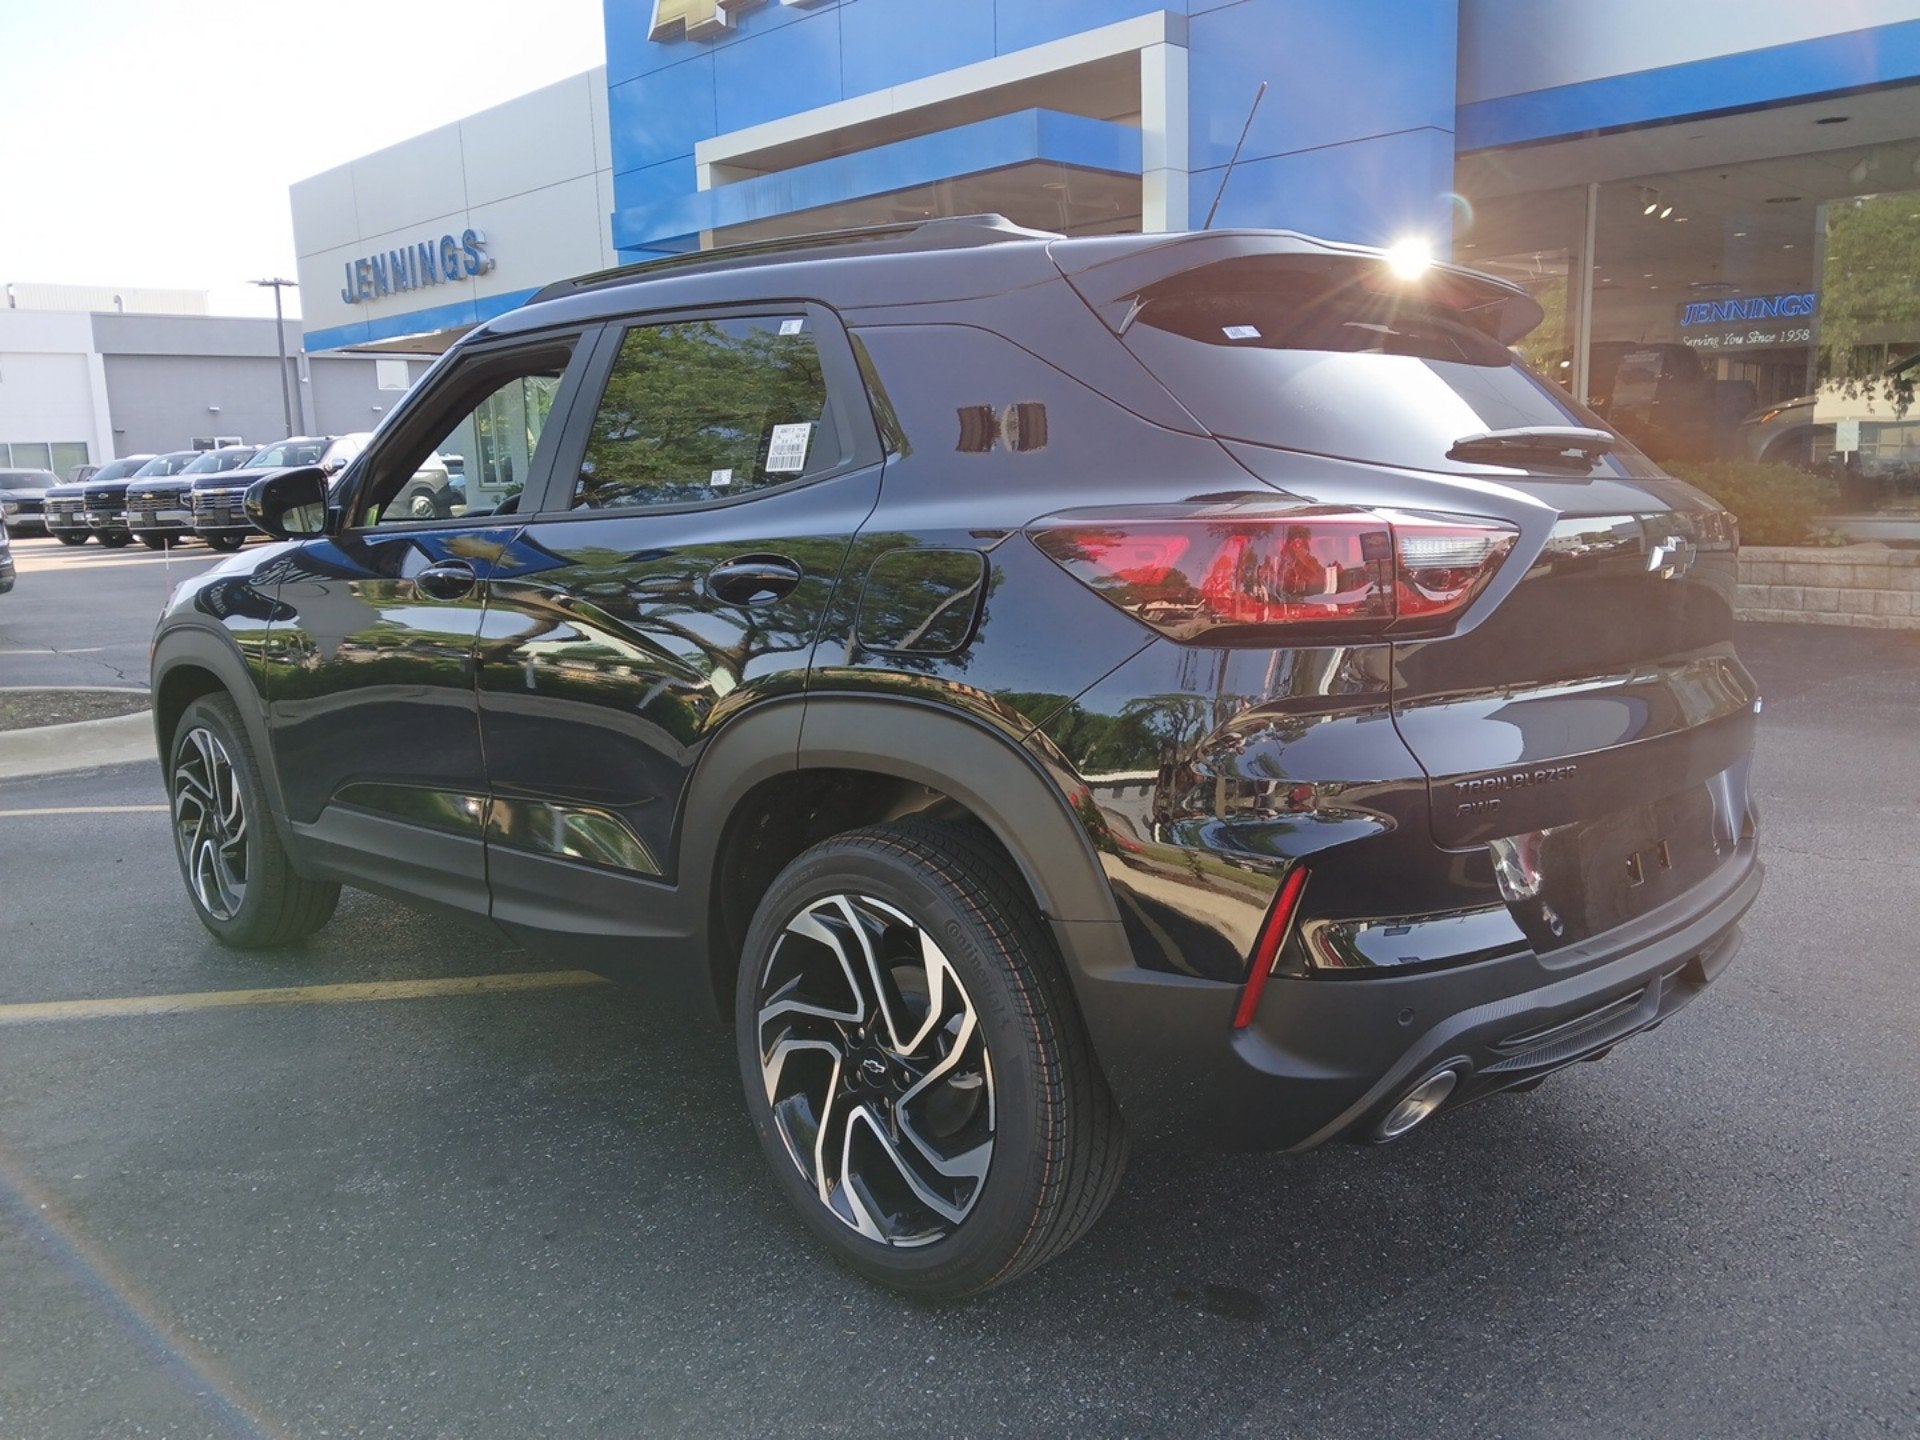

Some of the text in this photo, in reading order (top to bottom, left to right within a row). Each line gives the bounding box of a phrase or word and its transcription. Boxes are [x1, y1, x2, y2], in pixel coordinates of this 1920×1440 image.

[341, 229, 487, 304] JENNINGS
[1680, 293, 1816, 326] JENNINGS
[1682, 329, 1810, 348] Serving You Since 1958
[1454, 764, 1577, 795] TRAILBLAZER
